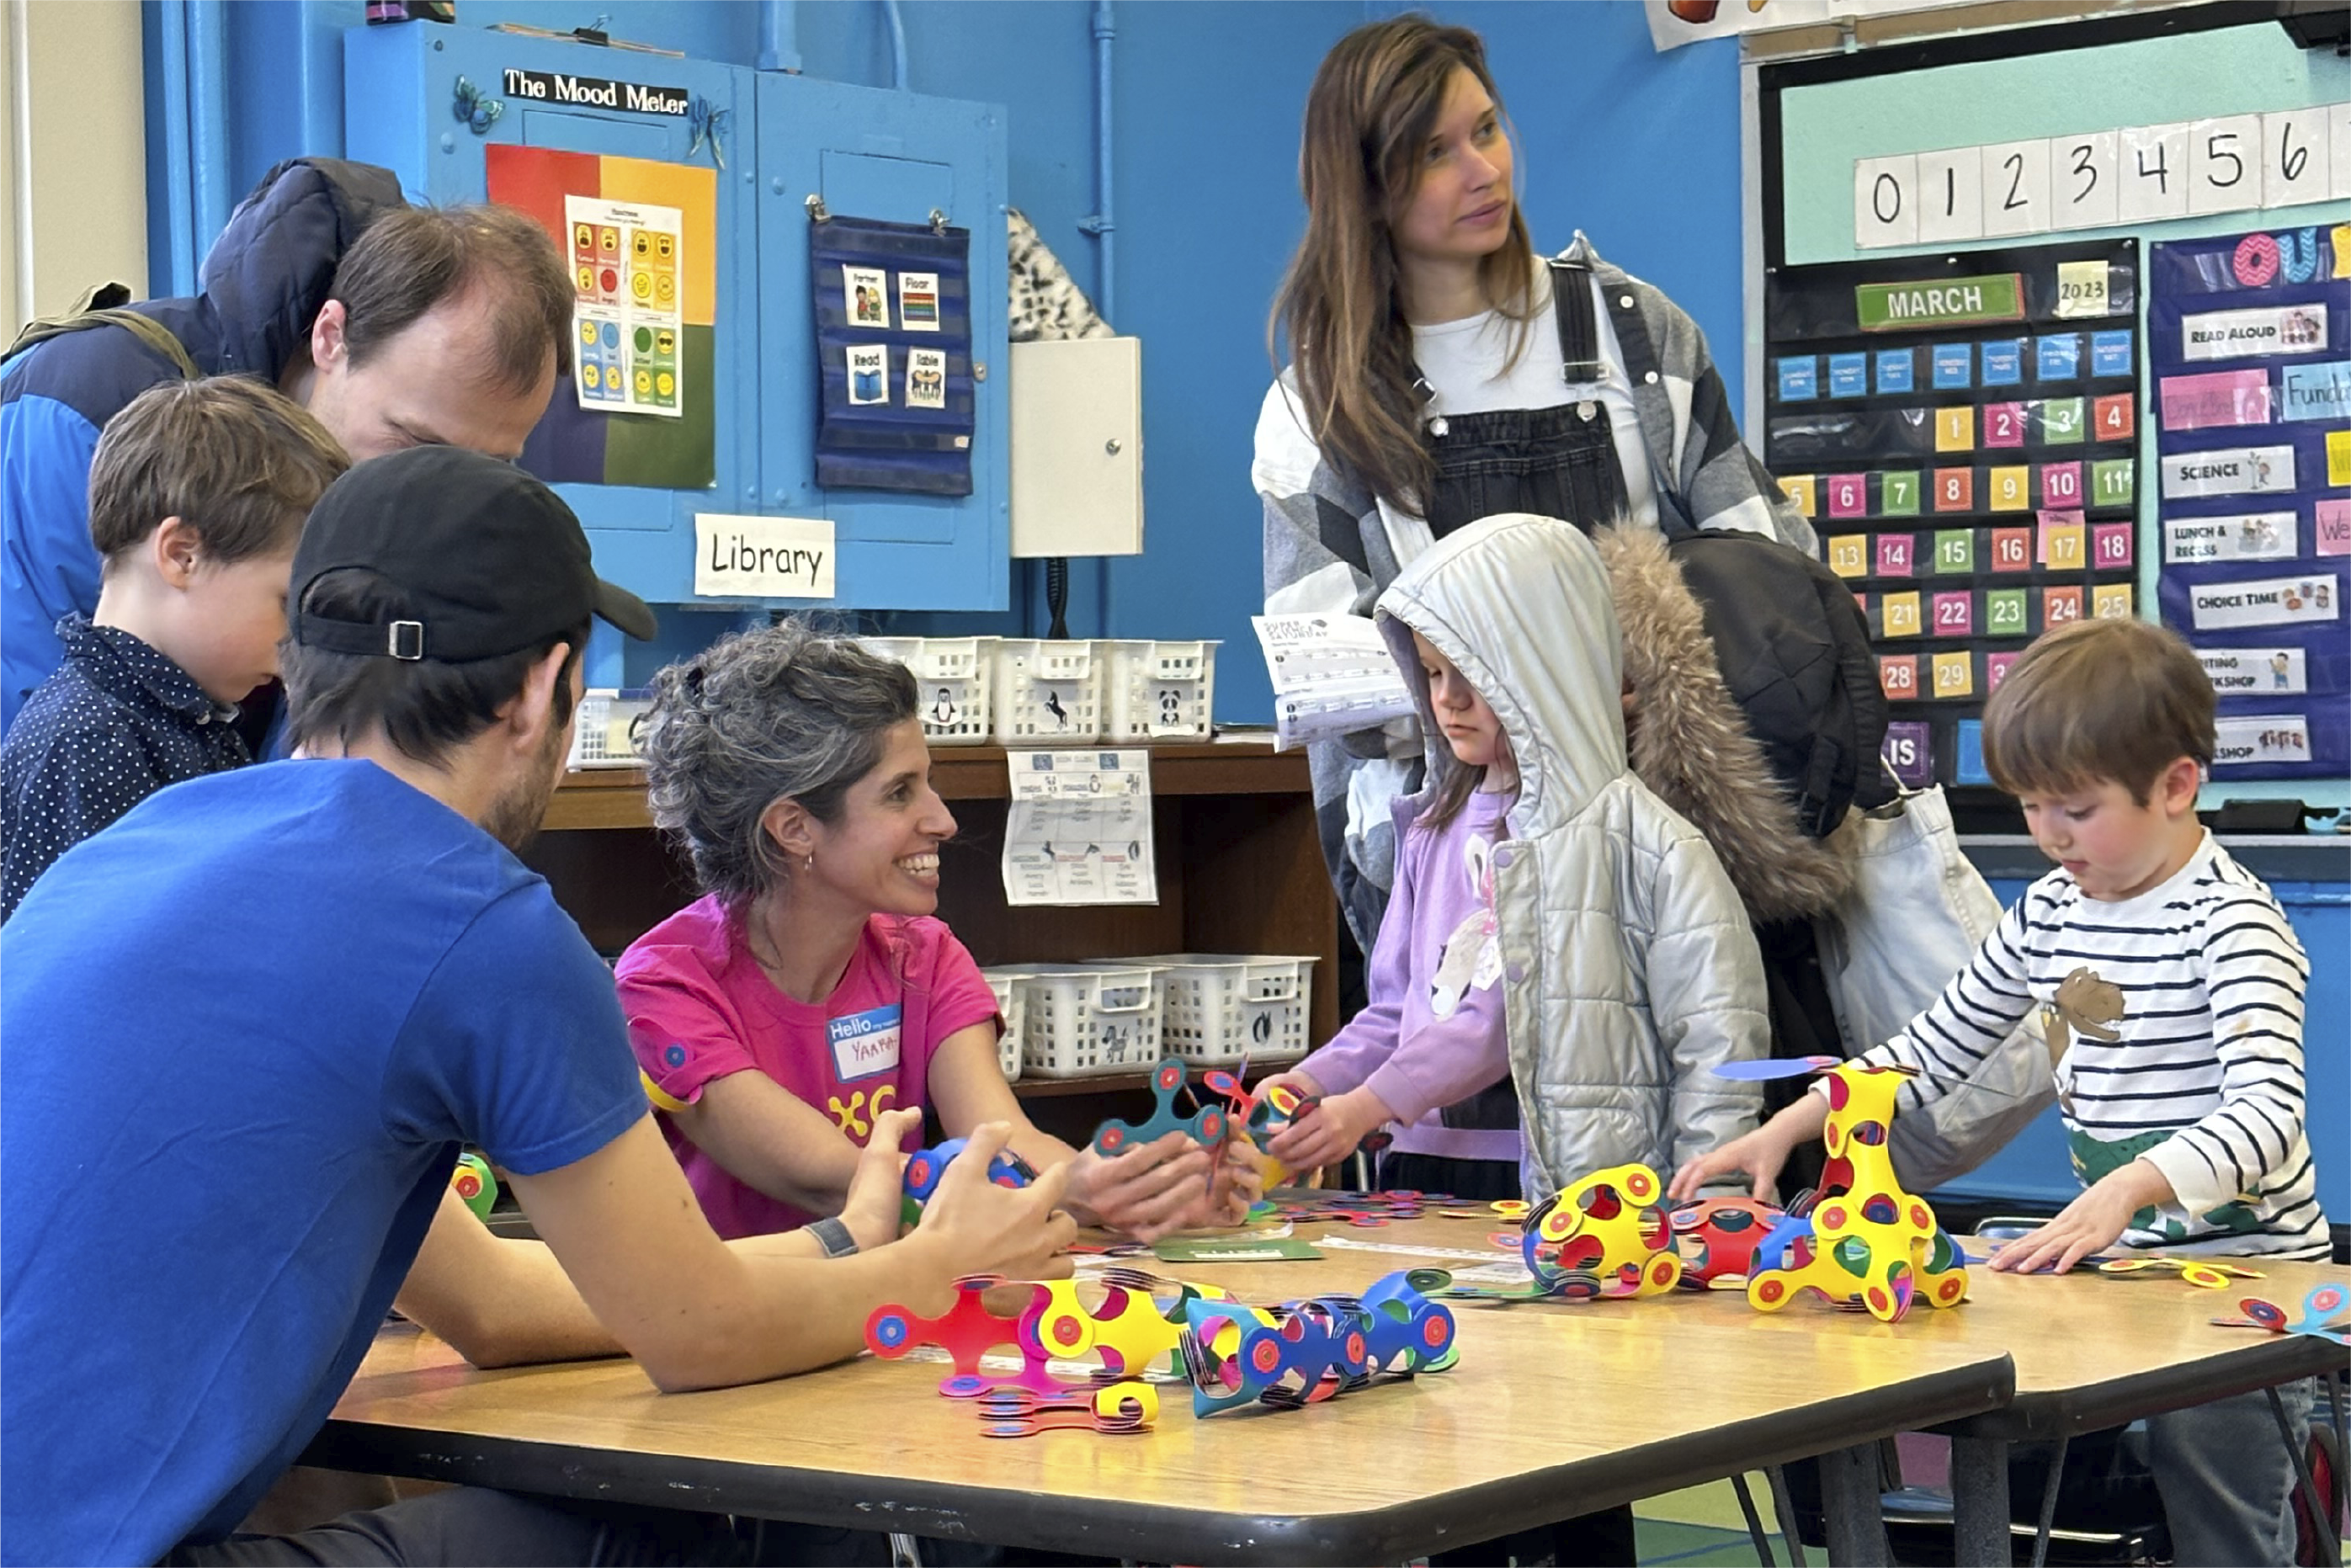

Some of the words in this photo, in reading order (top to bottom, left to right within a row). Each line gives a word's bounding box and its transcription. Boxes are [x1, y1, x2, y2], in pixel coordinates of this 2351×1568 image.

[504, 68, 545, 98] The
[554, 75, 617, 107] Mood
[626, 85, 688, 114] Meter
[1874, 173, 1900, 224] 0
[1947, 167, 1955, 216] 1
[2003, 153, 2028, 210] 2
[2070, 145, 2098, 204] 3
[2137, 141, 2168, 194] 4
[2207, 134, 2242, 188] 5
[2281, 122, 2307, 181] 6
[905, 277, 929, 290] Floor
[2061, 280, 2104, 300] 2023
[1888, 286, 1982, 319] MARCH
[2191, 331, 2225, 343] READ
[2228, 326, 2276, 341] ALOUD
[854, 353, 880, 367] Read
[916, 353, 939, 367] Table
[1950, 416, 1960, 439] 1
[1996, 413, 2011, 436] 2
[2058, 411, 2072, 433] 3
[2107, 405, 2121, 428] 4
[2104, 470, 2124, 494] 11
[2180, 463, 2240, 481] SCIENCE
[1895, 482, 1907, 505] 7
[1946, 478, 1960, 501] 8
[2003, 478, 2017, 500] 9
[2050, 472, 2074, 497] 10
[1790, 486, 1802, 508] 5
[1840, 485, 1854, 508] 6
[2174, 527, 2215, 539] LUNCH
[2217, 525, 2227, 537] &
[1838, 545, 1859, 566] 13
[1884, 544, 1905, 566] 14
[1944, 540, 1966, 563] 15
[2000, 539, 2024, 561] 16
[2055, 537, 2077, 559] 17
[2102, 534, 2125, 559] 18
[2174, 545, 2217, 557] RECSS
[712, 533, 822, 587] Library
[1993, 599, 2020, 623] 23
[2050, 598, 2077, 621] 24
[2099, 596, 2125, 620] 25
[2197, 596, 2242, 609] CHOICE
[2246, 593, 2278, 605] TIME
[1891, 604, 1912, 625] 21
[1939, 602, 1966, 625] 22
[1886, 665, 1912, 688] 28
[1939, 664, 1965, 687] 29
[1993, 663, 2007, 684] 3
[1890, 738, 1915, 766] IS
[830, 1018, 871, 1039] Hello
